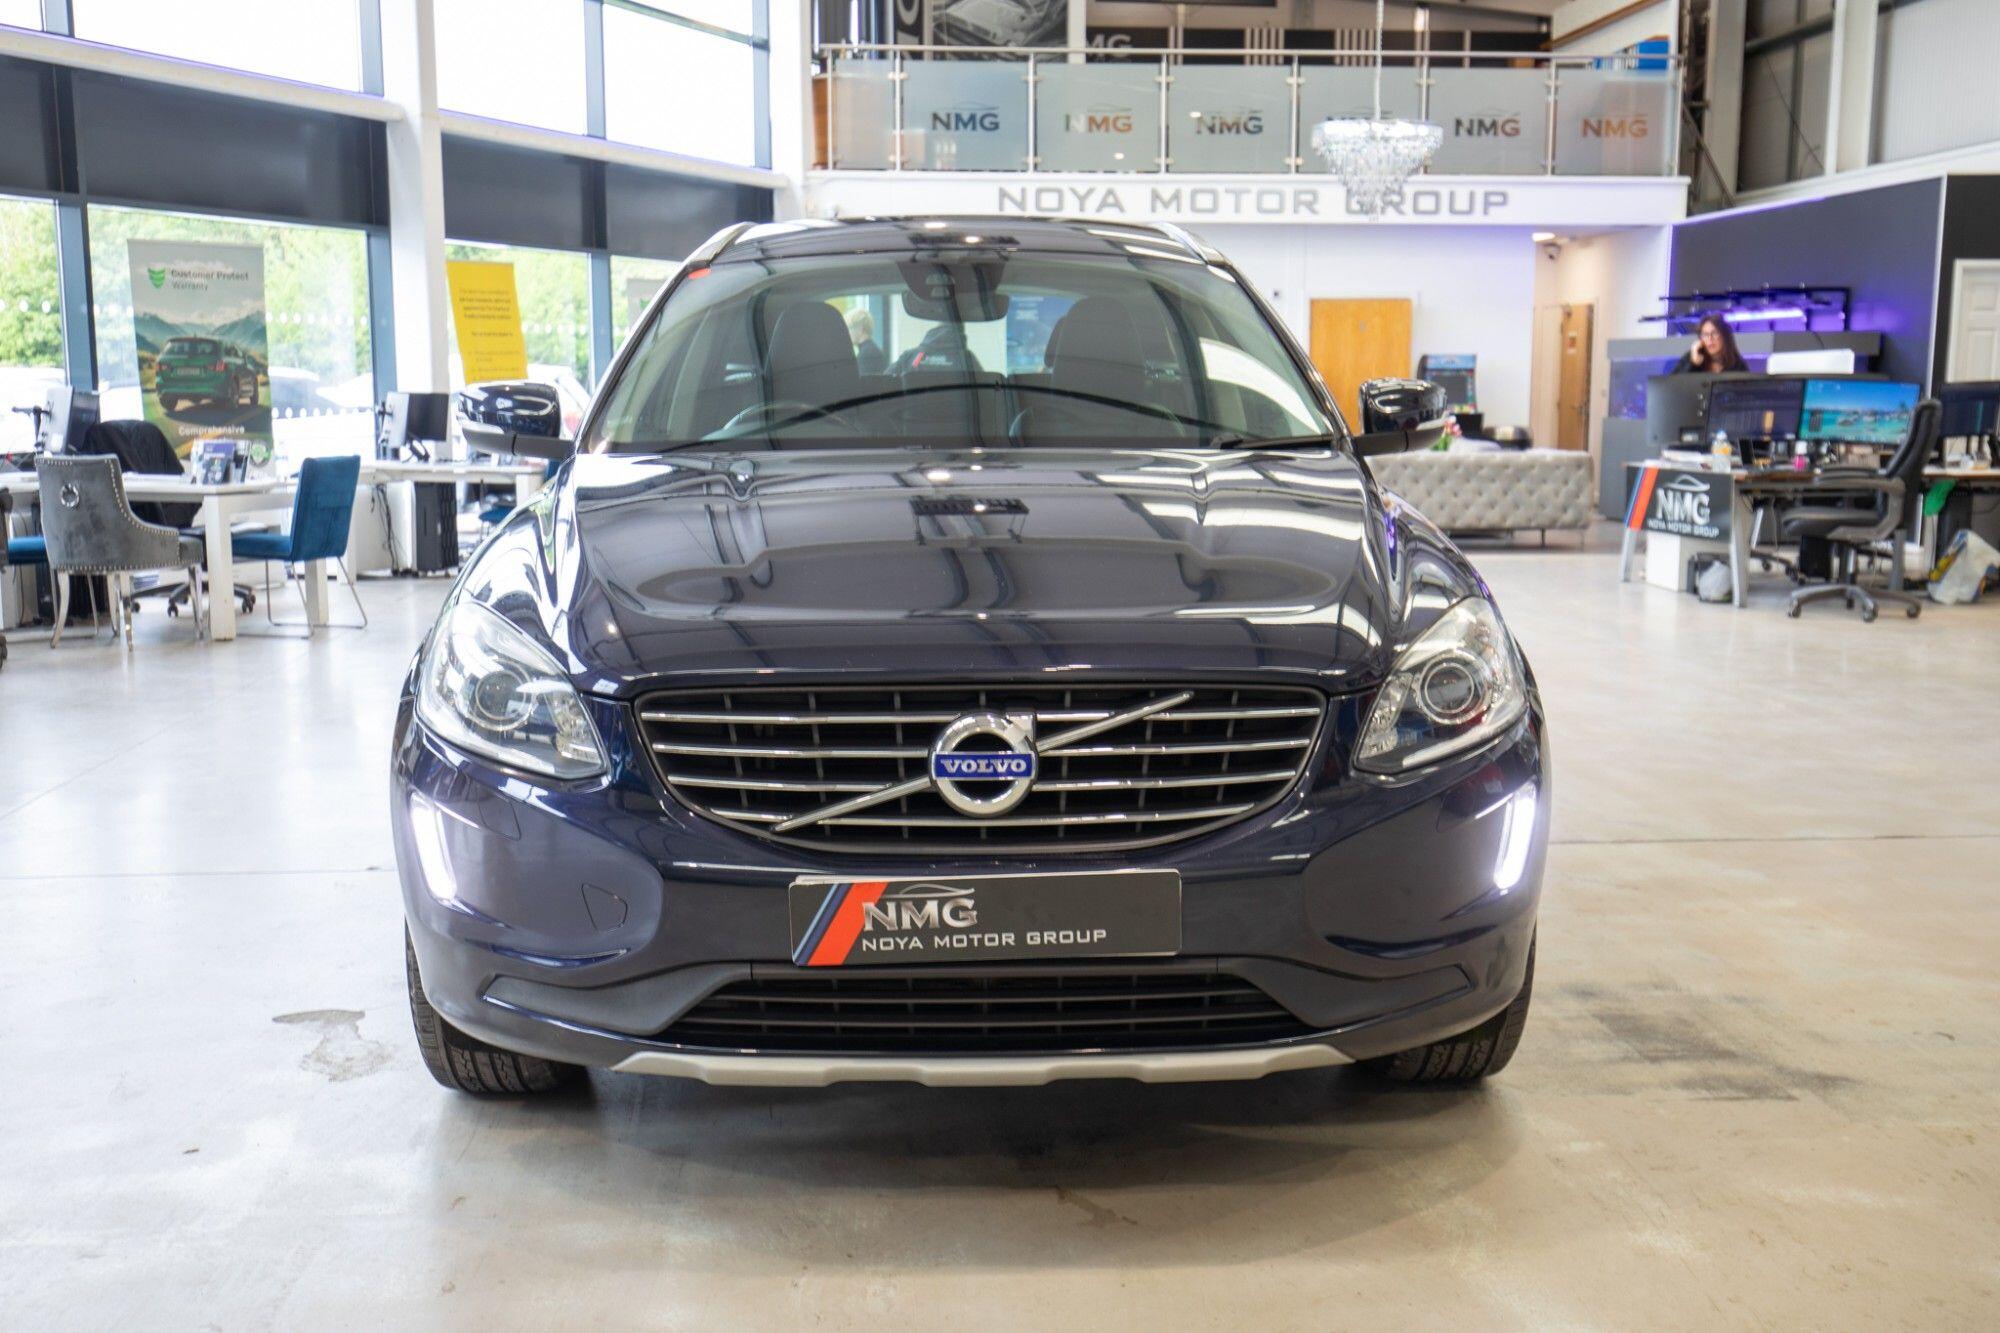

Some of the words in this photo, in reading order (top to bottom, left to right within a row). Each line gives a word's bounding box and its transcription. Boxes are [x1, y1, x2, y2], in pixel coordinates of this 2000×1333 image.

[932, 112, 1000, 132] NMG
[1064, 115, 1133, 134] NMG
[1195, 116, 1264, 135] NMG
[1454, 118, 1521, 138] NMG
[1582, 118, 1648, 138] NMG
[998, 187, 1126, 213] NOYA
[1150, 187, 1320, 215] MOTOR
[171, 269, 214, 279] Customer
[217, 271, 249, 281] Protect
[179, 425, 245, 435] Comprehensive
[1656, 488, 1710, 525] NMG
[1647, 519, 1667, 530] NOYA
[1668, 521, 1692, 535] MOTOR
[1693, 524, 1720, 538] GROUP
[940, 758, 1028, 774] VOLVO
[862, 898, 977, 931] NMG
[861, 936, 924, 952] NOYA
[934, 932, 1016, 949] MOTOR
[1026, 929, 1108, 945] GROUP
